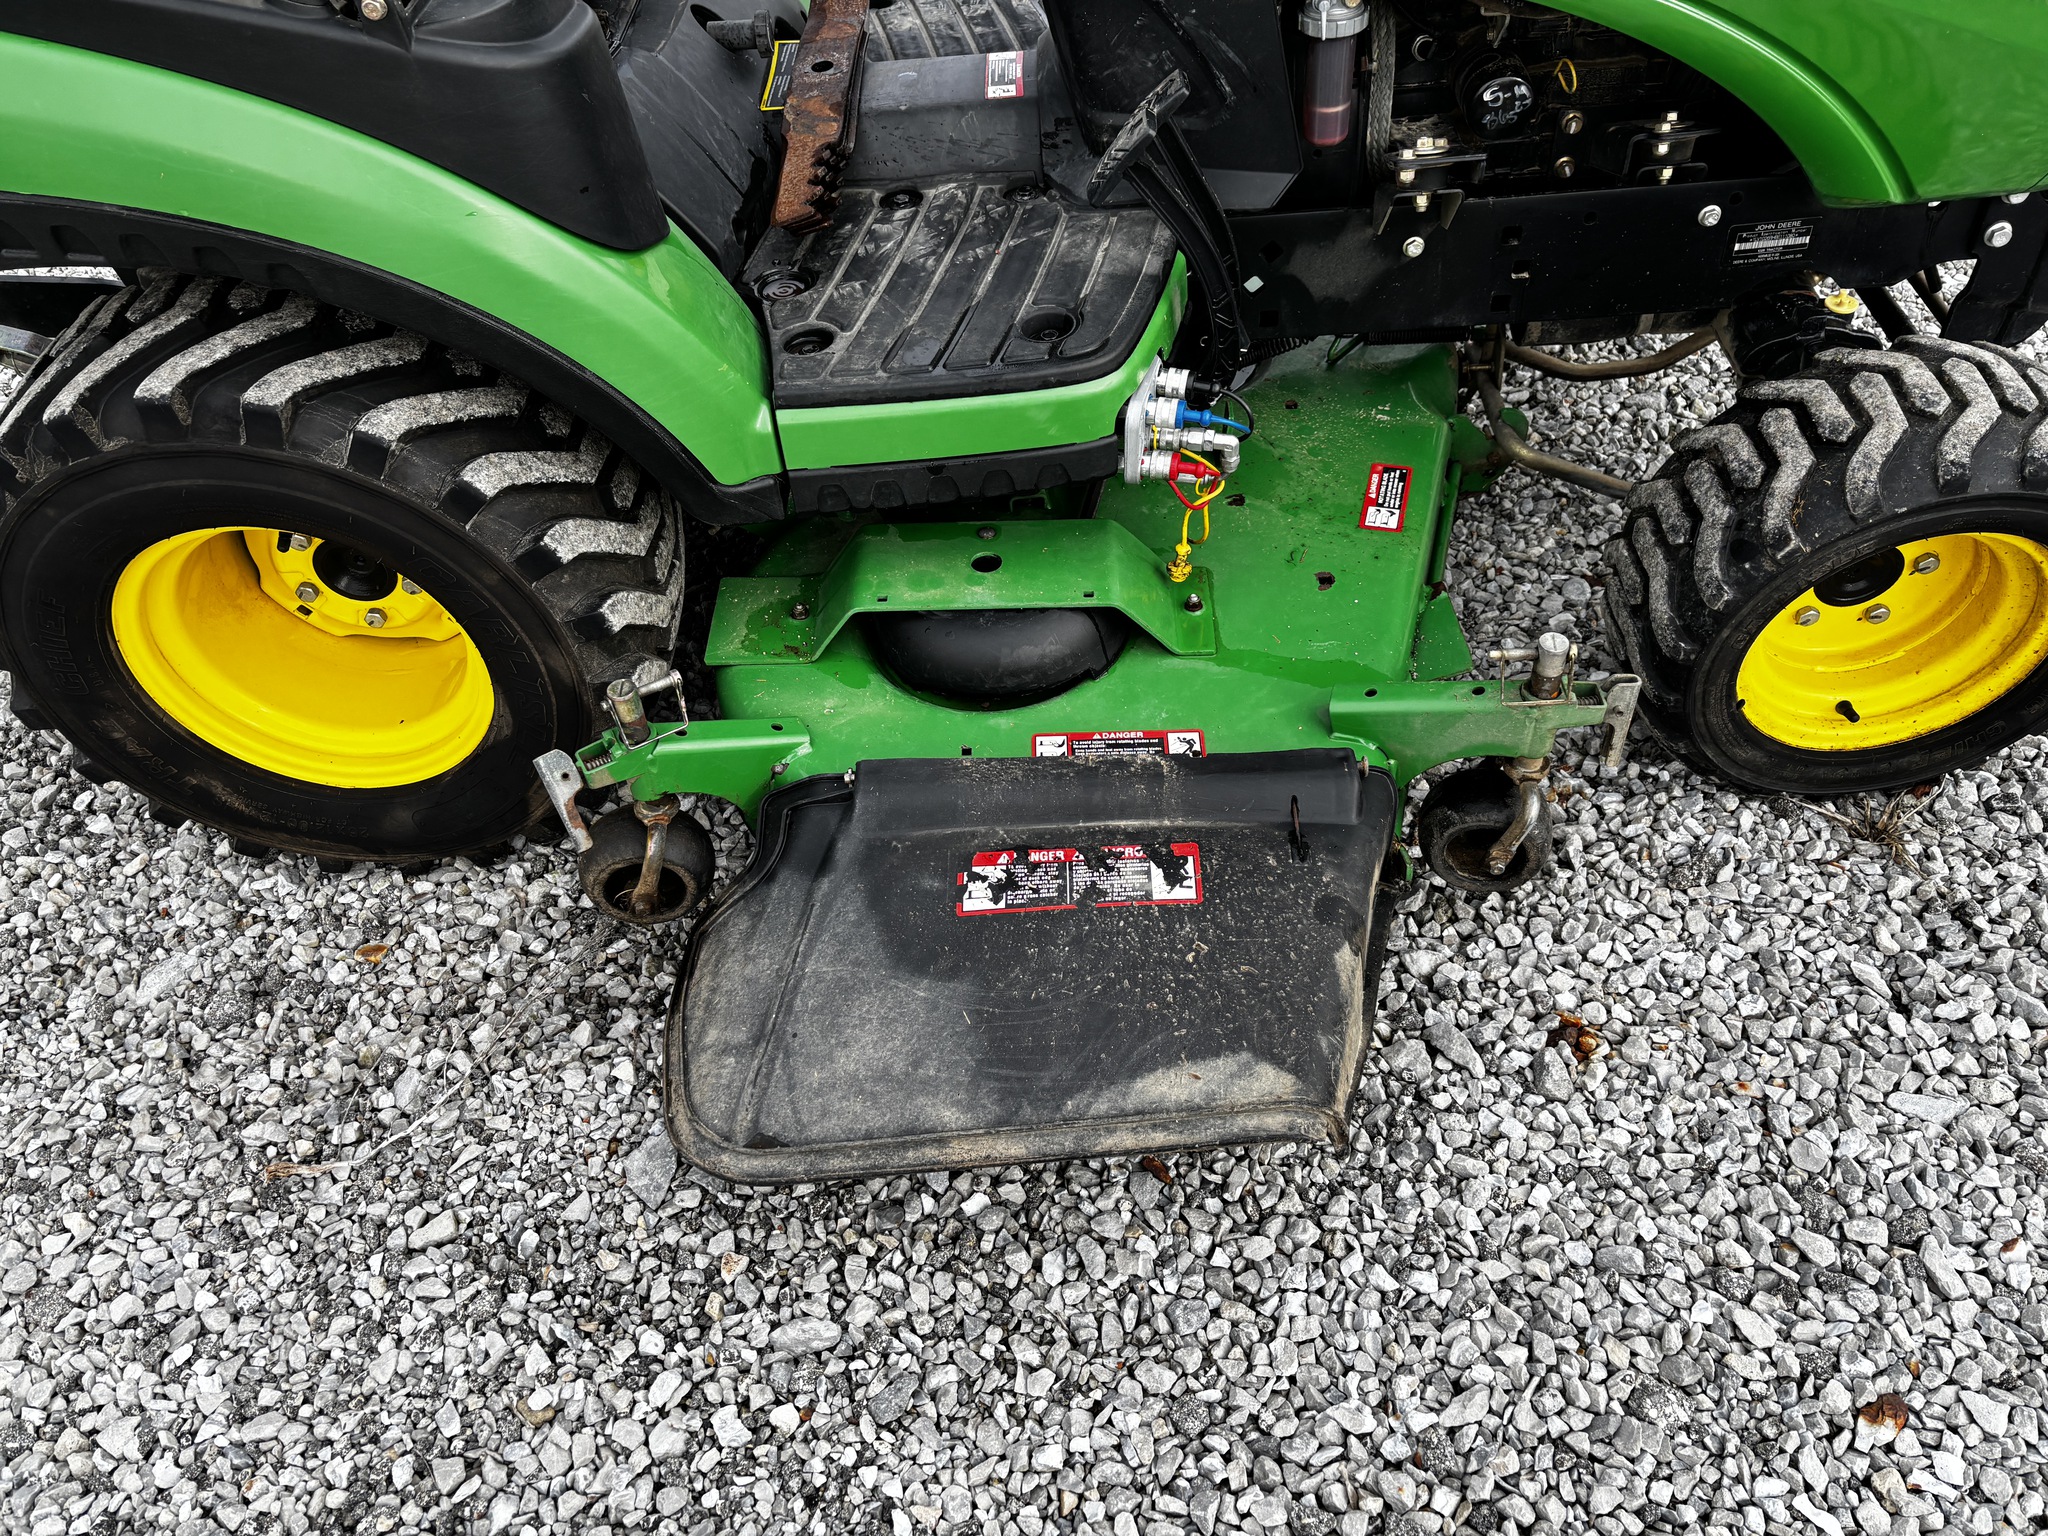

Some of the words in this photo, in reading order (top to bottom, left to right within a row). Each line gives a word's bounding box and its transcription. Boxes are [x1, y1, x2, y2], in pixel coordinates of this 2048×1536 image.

[1369, 473, 1379, 493] DANGER
[37, 587, 90, 697] CHIEF
[87, 713, 199, 797] TRAC
